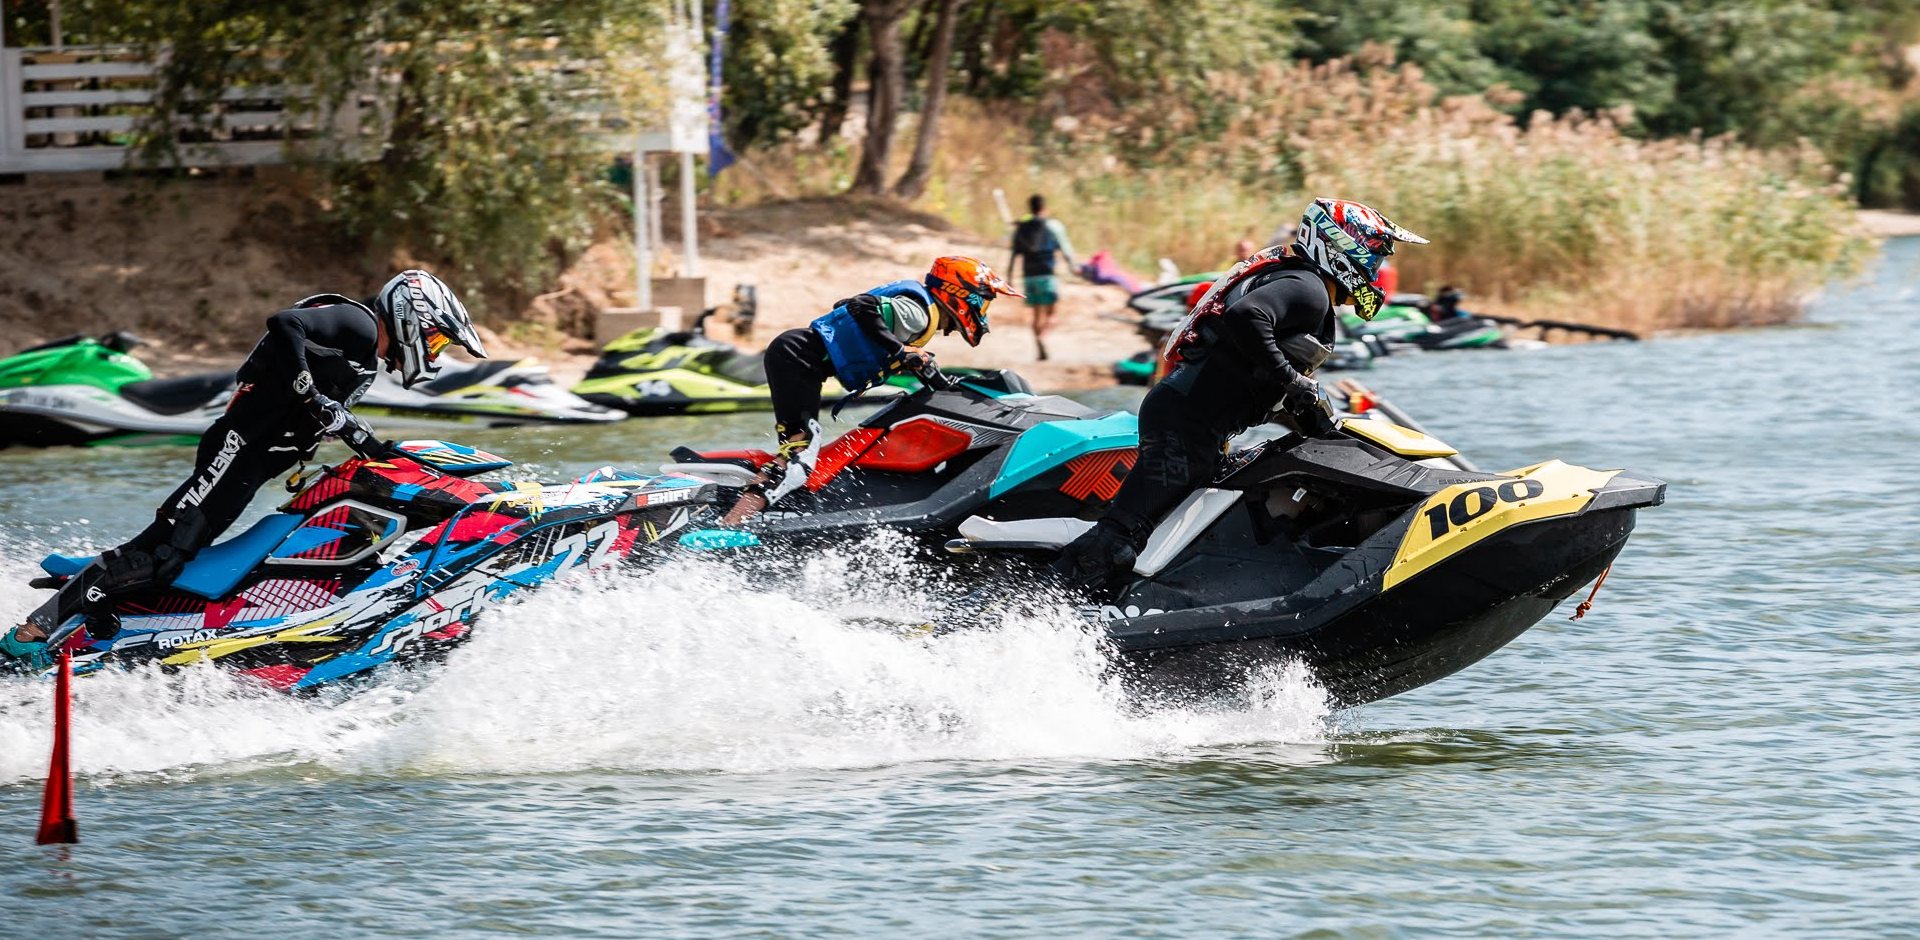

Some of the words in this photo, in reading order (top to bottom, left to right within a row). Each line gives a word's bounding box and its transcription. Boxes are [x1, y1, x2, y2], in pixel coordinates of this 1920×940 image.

[1317, 218, 1373, 263] 100%
[408, 279, 438, 329] 100%
[648, 489, 691, 505] SHIFT
[1424, 479, 1544, 541] 100
[553, 520, 620, 580] 22
[158, 629, 218, 649] ROTAX
